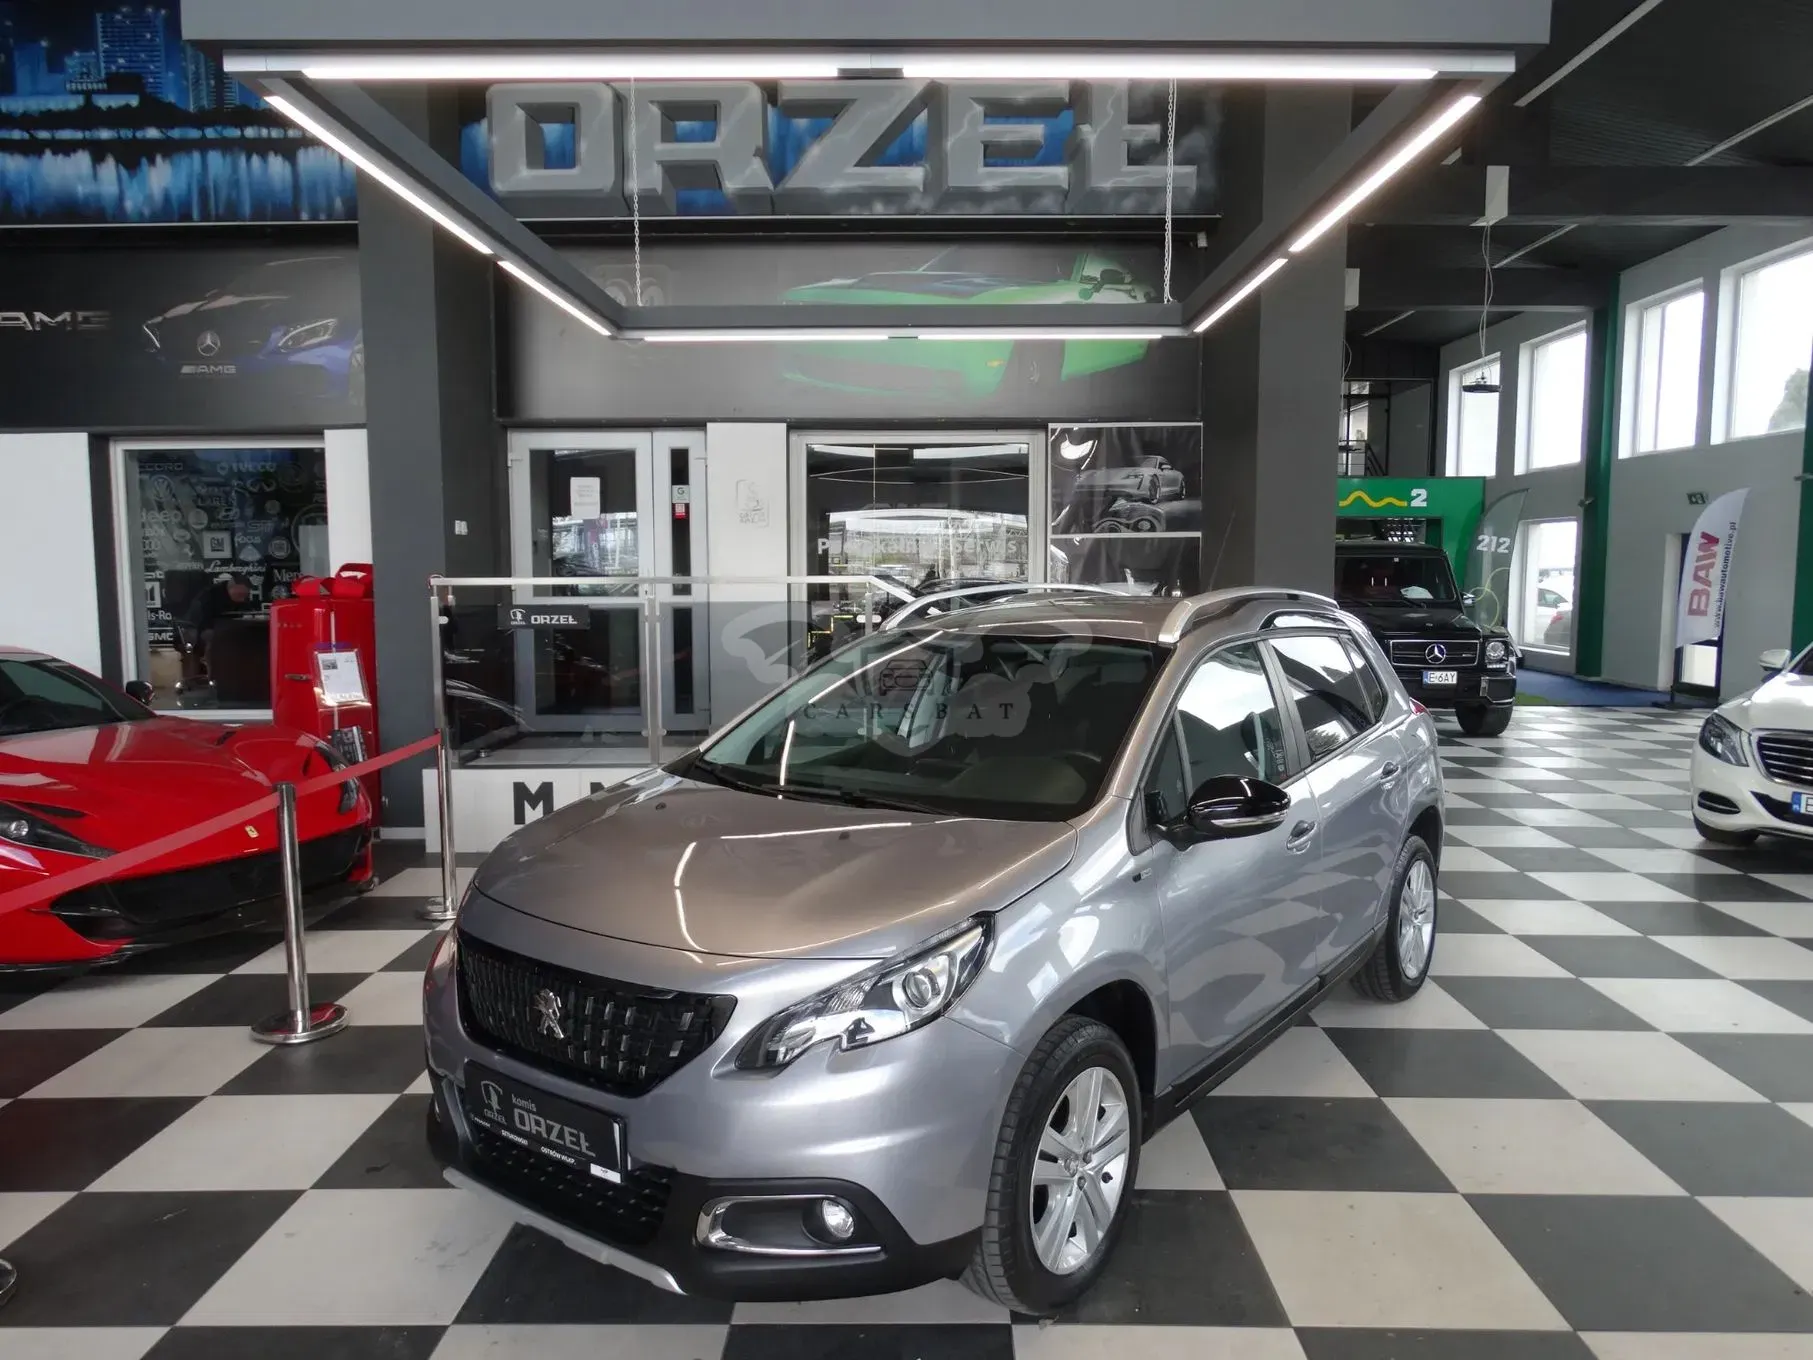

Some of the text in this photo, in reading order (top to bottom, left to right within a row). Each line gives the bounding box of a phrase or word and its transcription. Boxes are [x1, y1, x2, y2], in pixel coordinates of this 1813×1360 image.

[487, 80, 1198, 205] ORZEŁ
[198, 365, 236, 374] AMG
[1410, 488, 1427, 507] 2
[1476, 535, 1511, 553] 212
[204, 560, 267, 574] Lamborghini
[1687, 531, 1720, 616] BAW
[531, 615, 578, 624] ORZEŁ
[511, 1093, 537, 1112] komis
[513, 1108, 596, 1157] ORZEŁ
